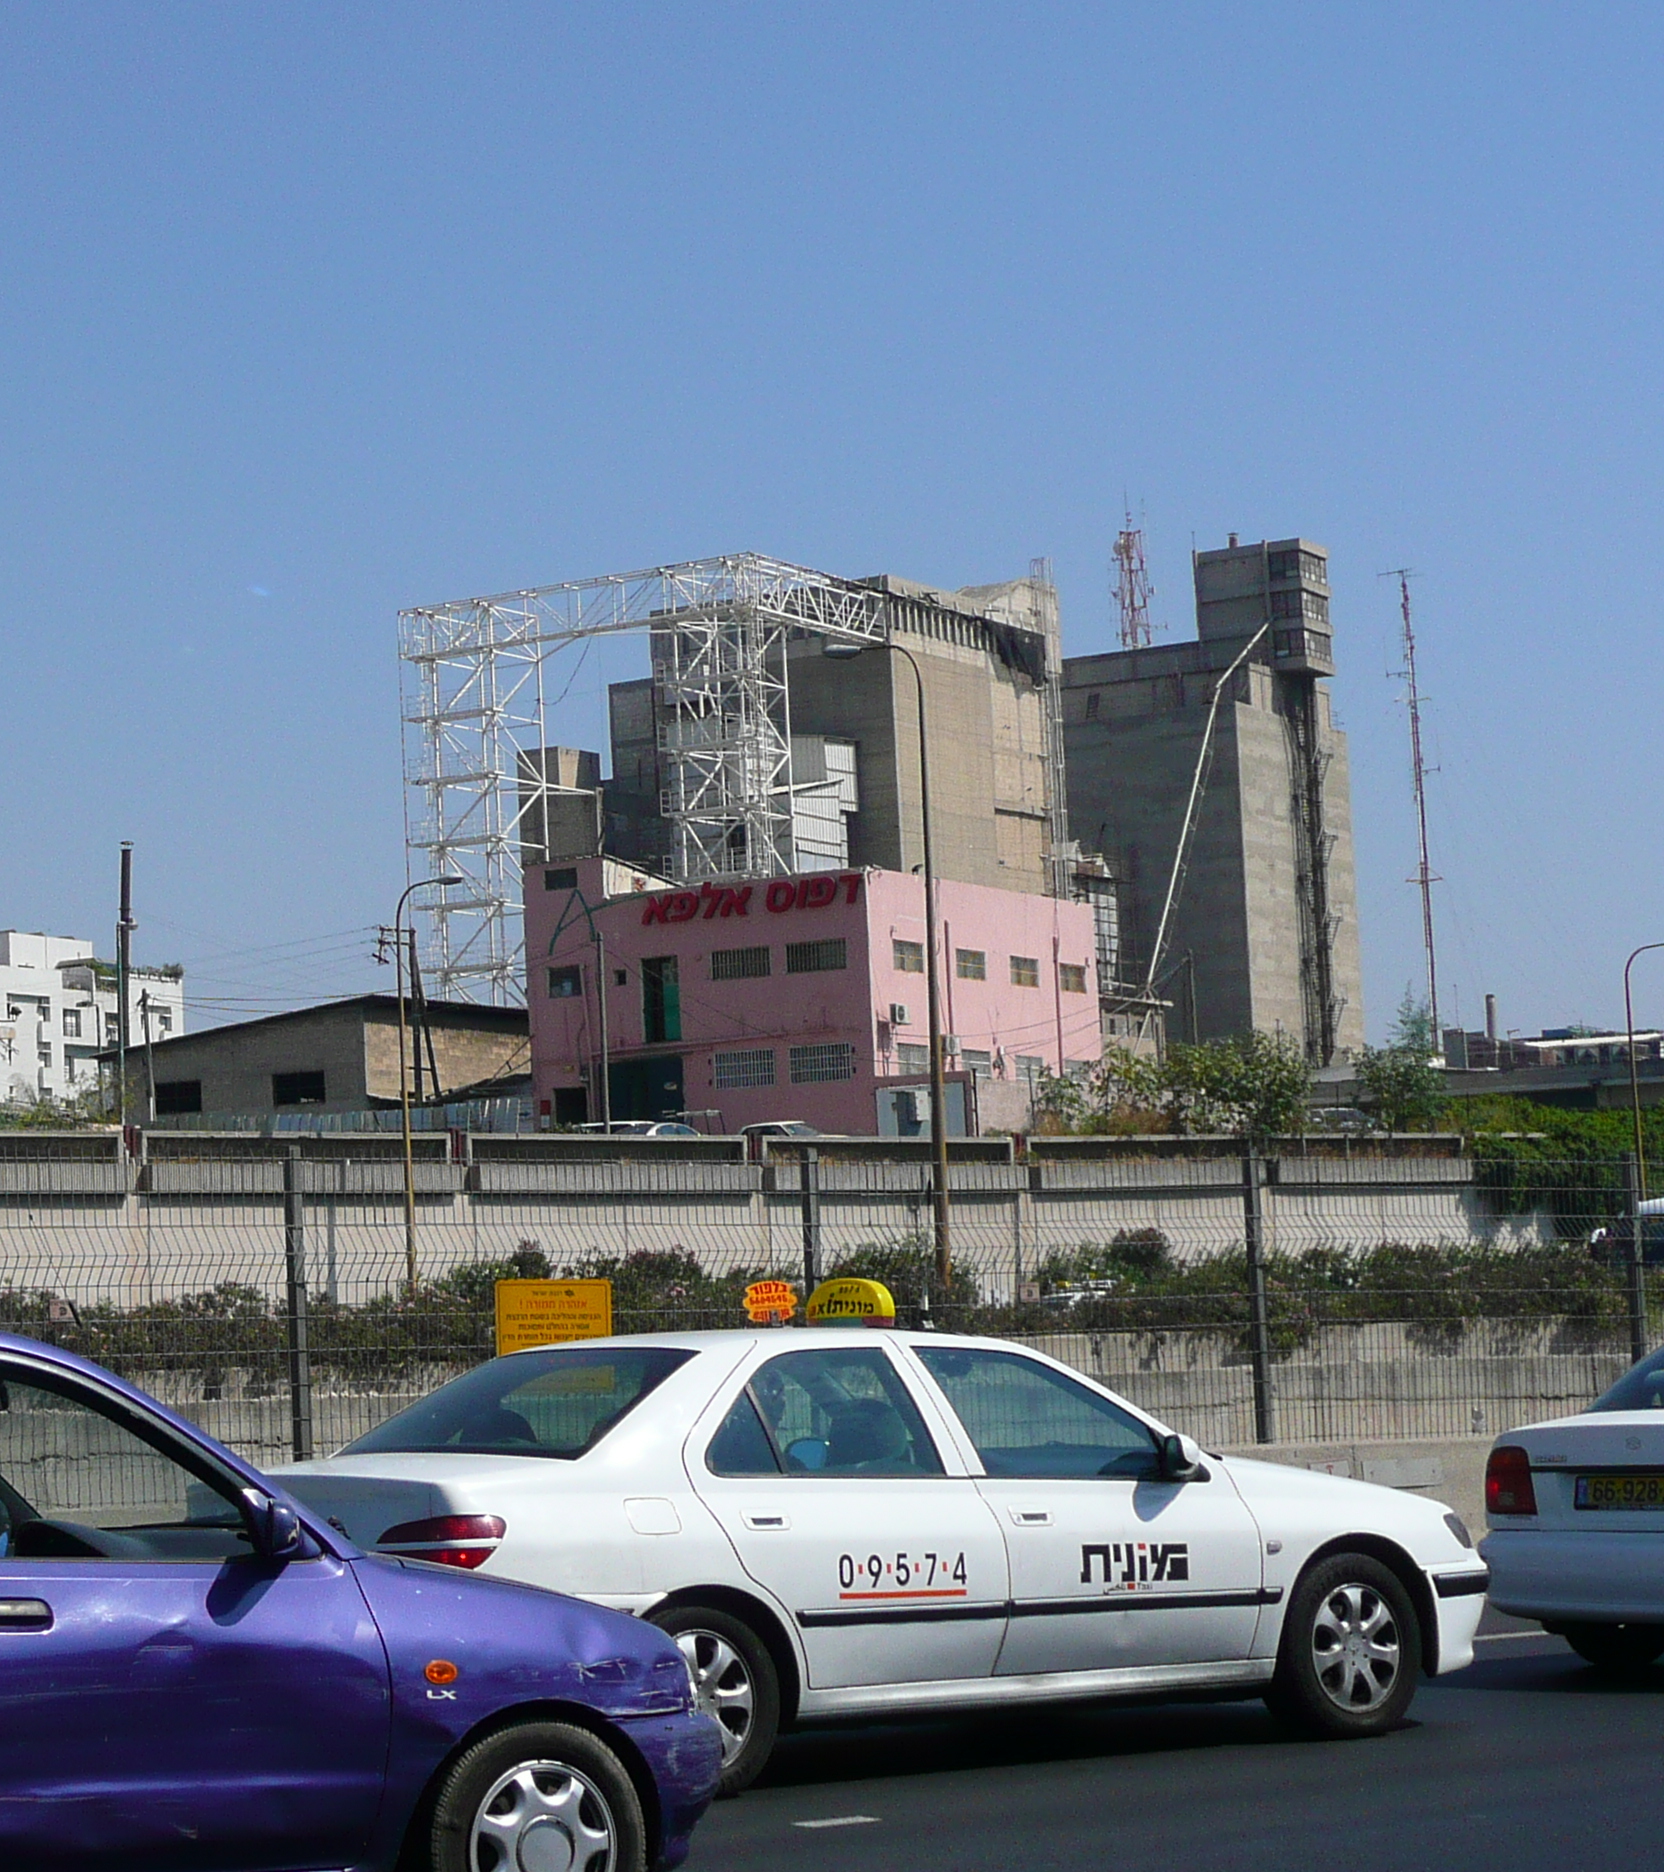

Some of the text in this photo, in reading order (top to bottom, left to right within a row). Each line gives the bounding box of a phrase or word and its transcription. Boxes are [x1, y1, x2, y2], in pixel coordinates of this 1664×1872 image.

[641, 874, 864, 926] דפוס אלפא
[526, 1300, 556, 1309] חמורה
[559, 1300, 588, 1309] אזהרה
[1080, 1543, 1188, 1583] מונית
[426, 1690, 456, 1700] LX
